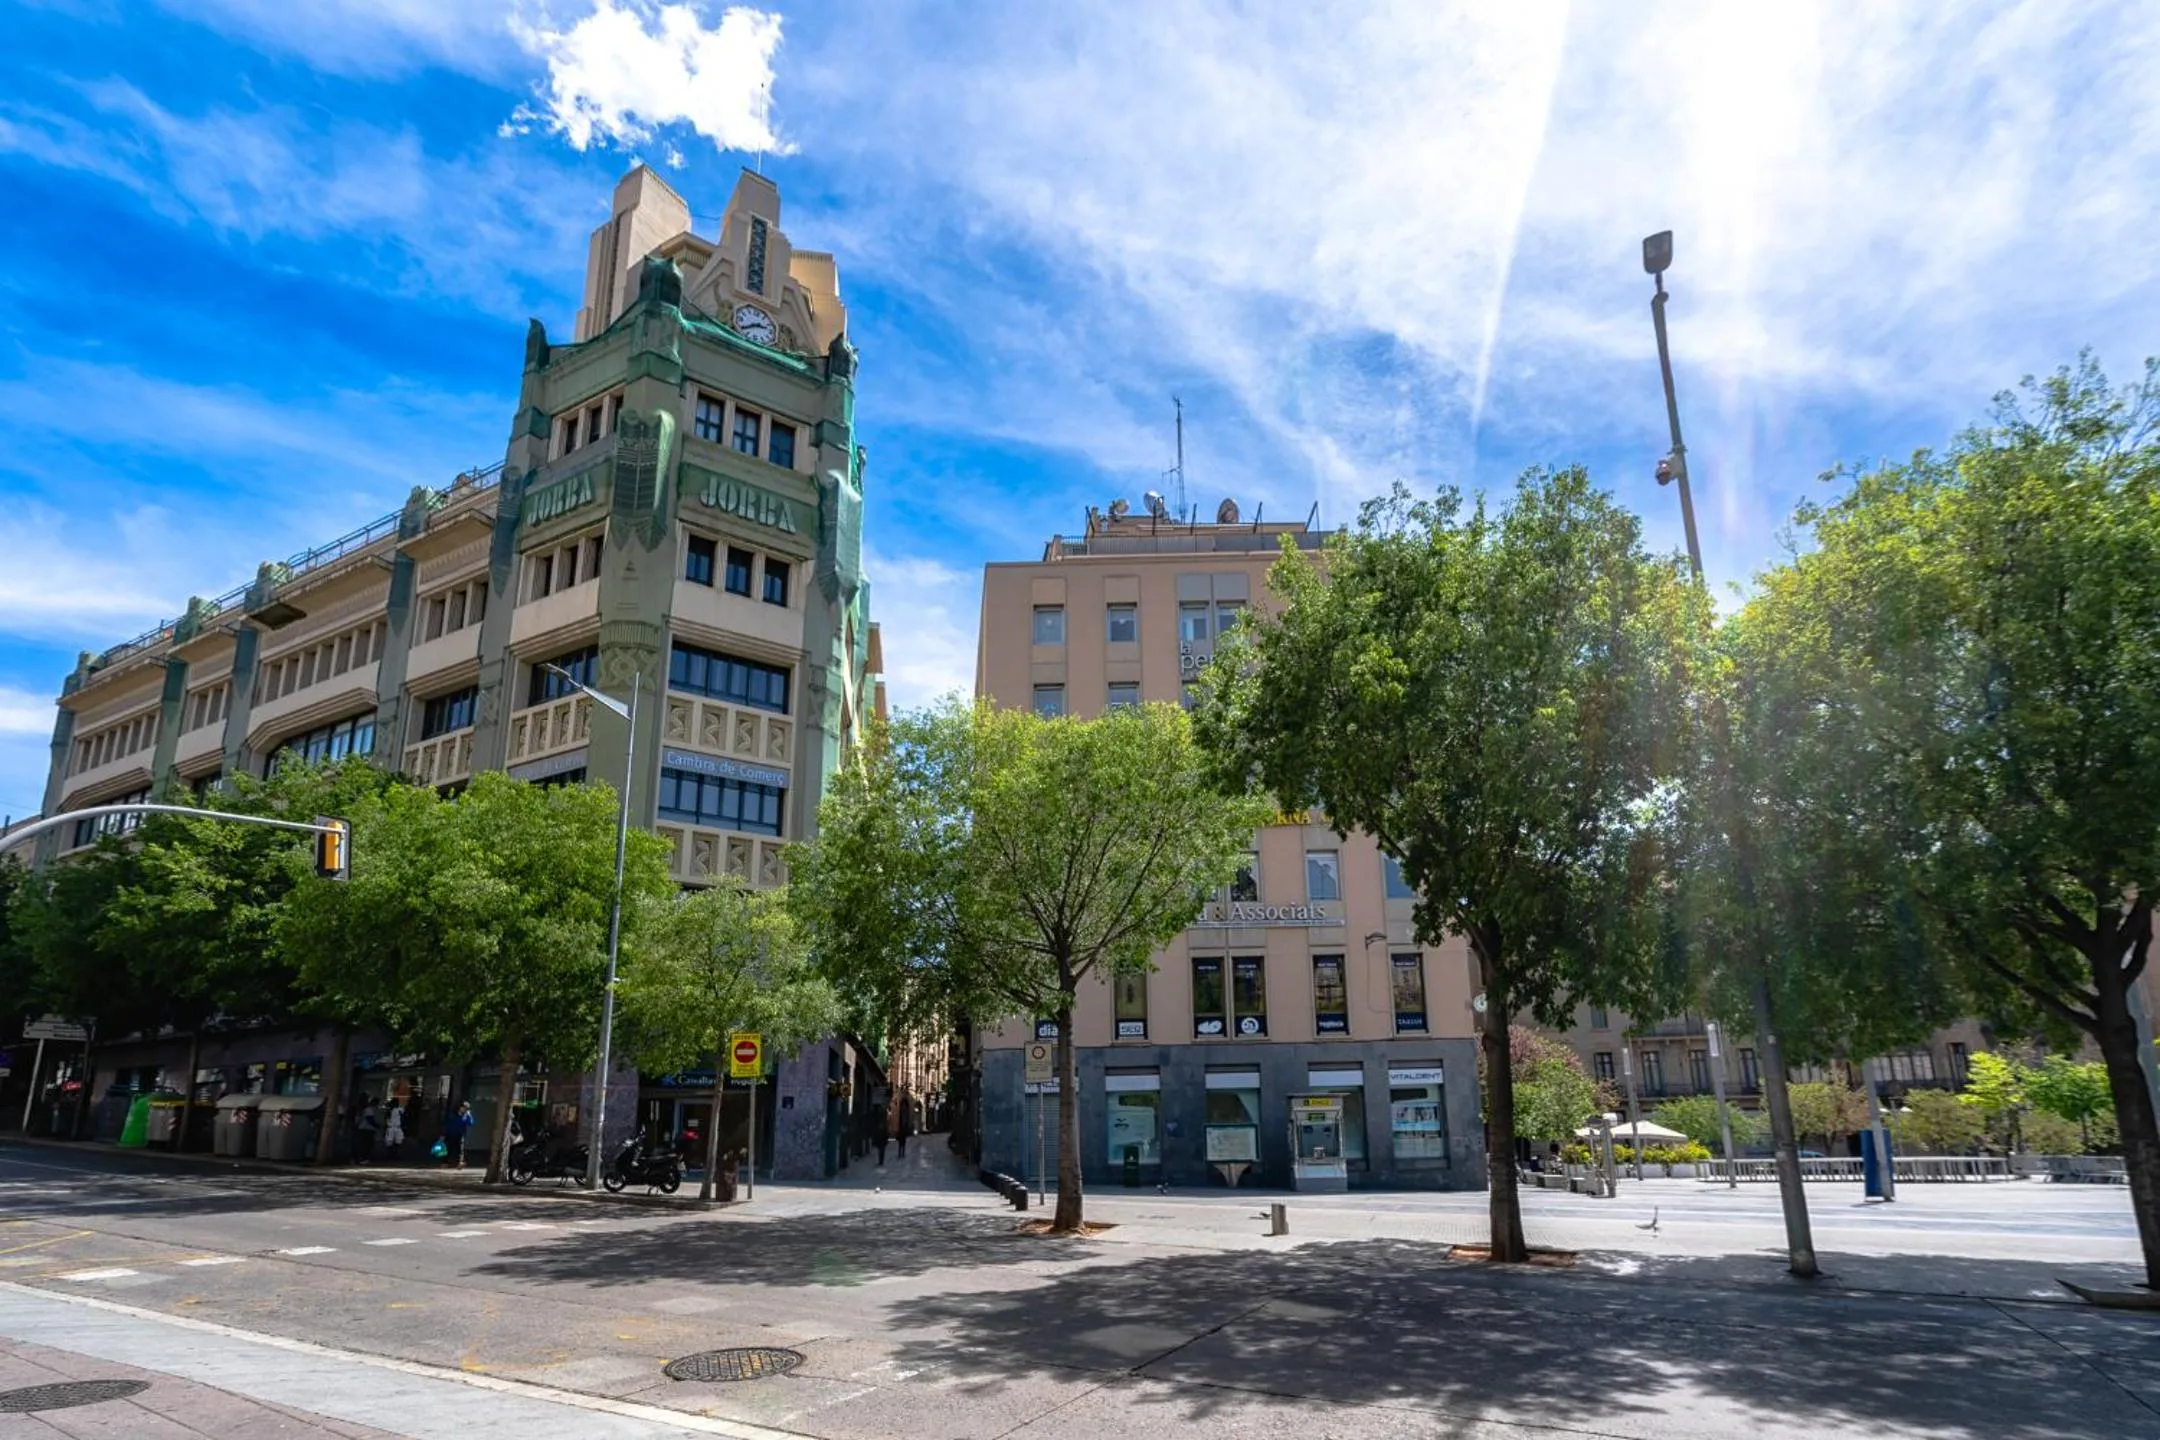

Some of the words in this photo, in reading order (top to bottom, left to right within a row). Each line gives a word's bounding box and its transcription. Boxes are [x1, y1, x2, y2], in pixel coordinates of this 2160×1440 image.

[526, 472, 592, 526] JORBA
[700, 475, 796, 533] JORBA
[667, 751, 716, 771] Cambra
[720, 760, 736, 774] de
[739, 766, 785, 786] Comerç
[1230, 901, 1326, 920] Associats
